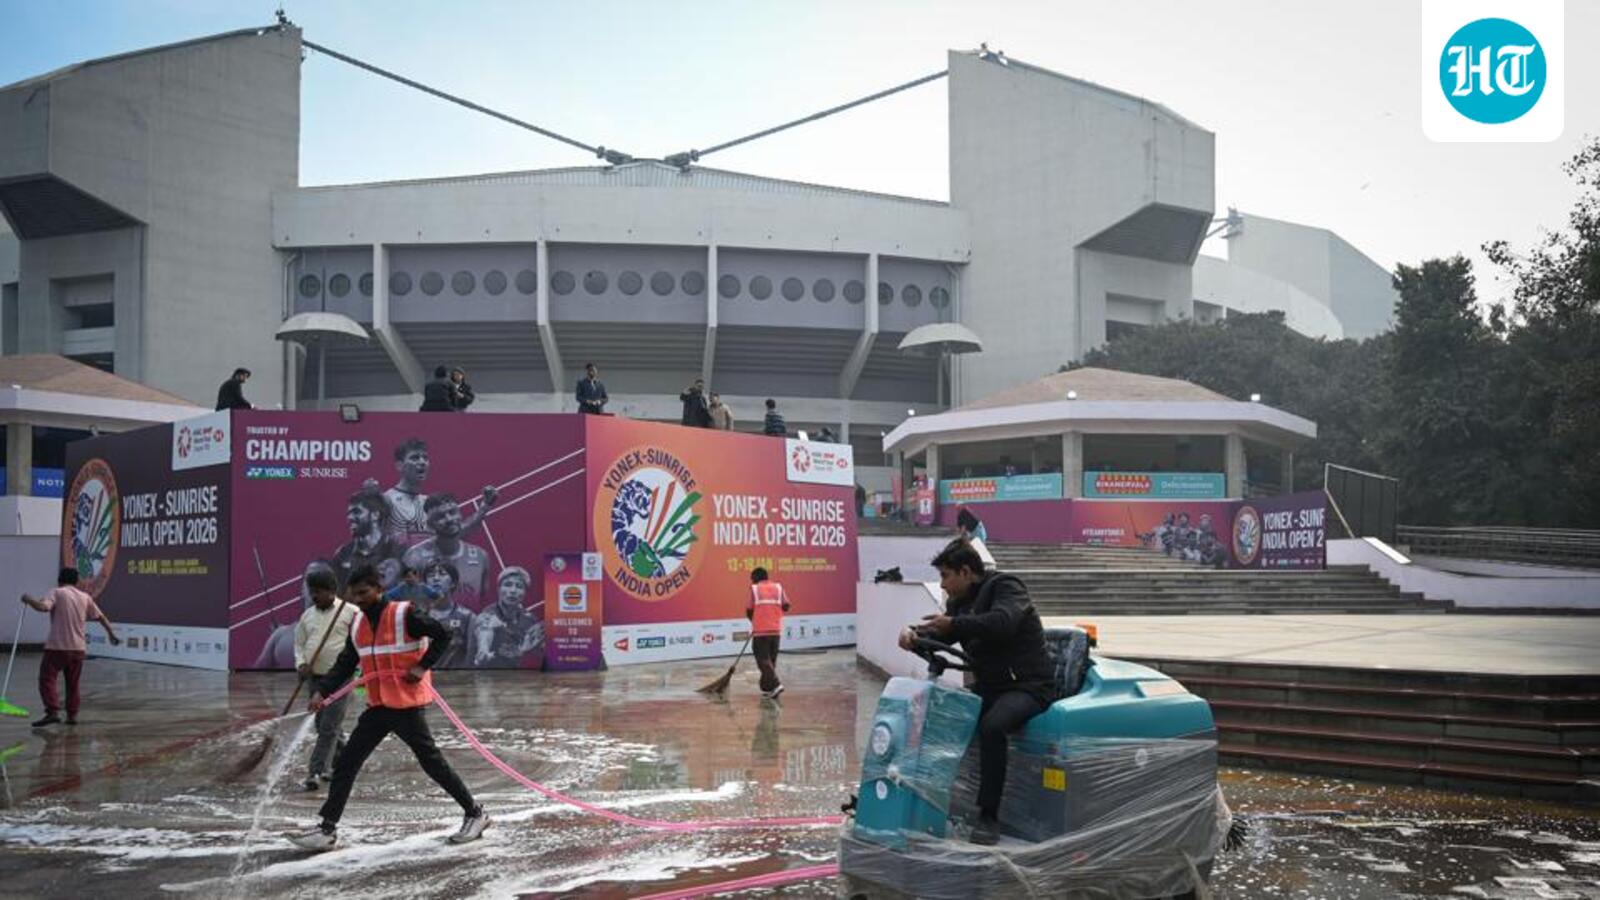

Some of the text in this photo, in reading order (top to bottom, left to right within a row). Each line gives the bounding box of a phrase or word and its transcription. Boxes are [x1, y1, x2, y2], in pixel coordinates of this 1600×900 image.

[246, 439, 372, 461] CHAMPIONS
[264, 467, 348, 478] YONEX SUNRISE
[122, 493, 158, 520] YONEX
[165, 485, 218, 517] SUNRISE
[712, 493, 768, 520] YONEX
[781, 497, 845, 523] SUNRISE
[121, 517, 218, 548] INDIA OPEN 2026
[713, 521, 846, 547] INDIA OPEN 2026
[1262, 511, 1293, 531] YONEX
[1262, 531, 1288, 550] INDIA
[1288, 529, 1315, 549] OPEN
[614, 565, 691, 597] INDIA OPEN
